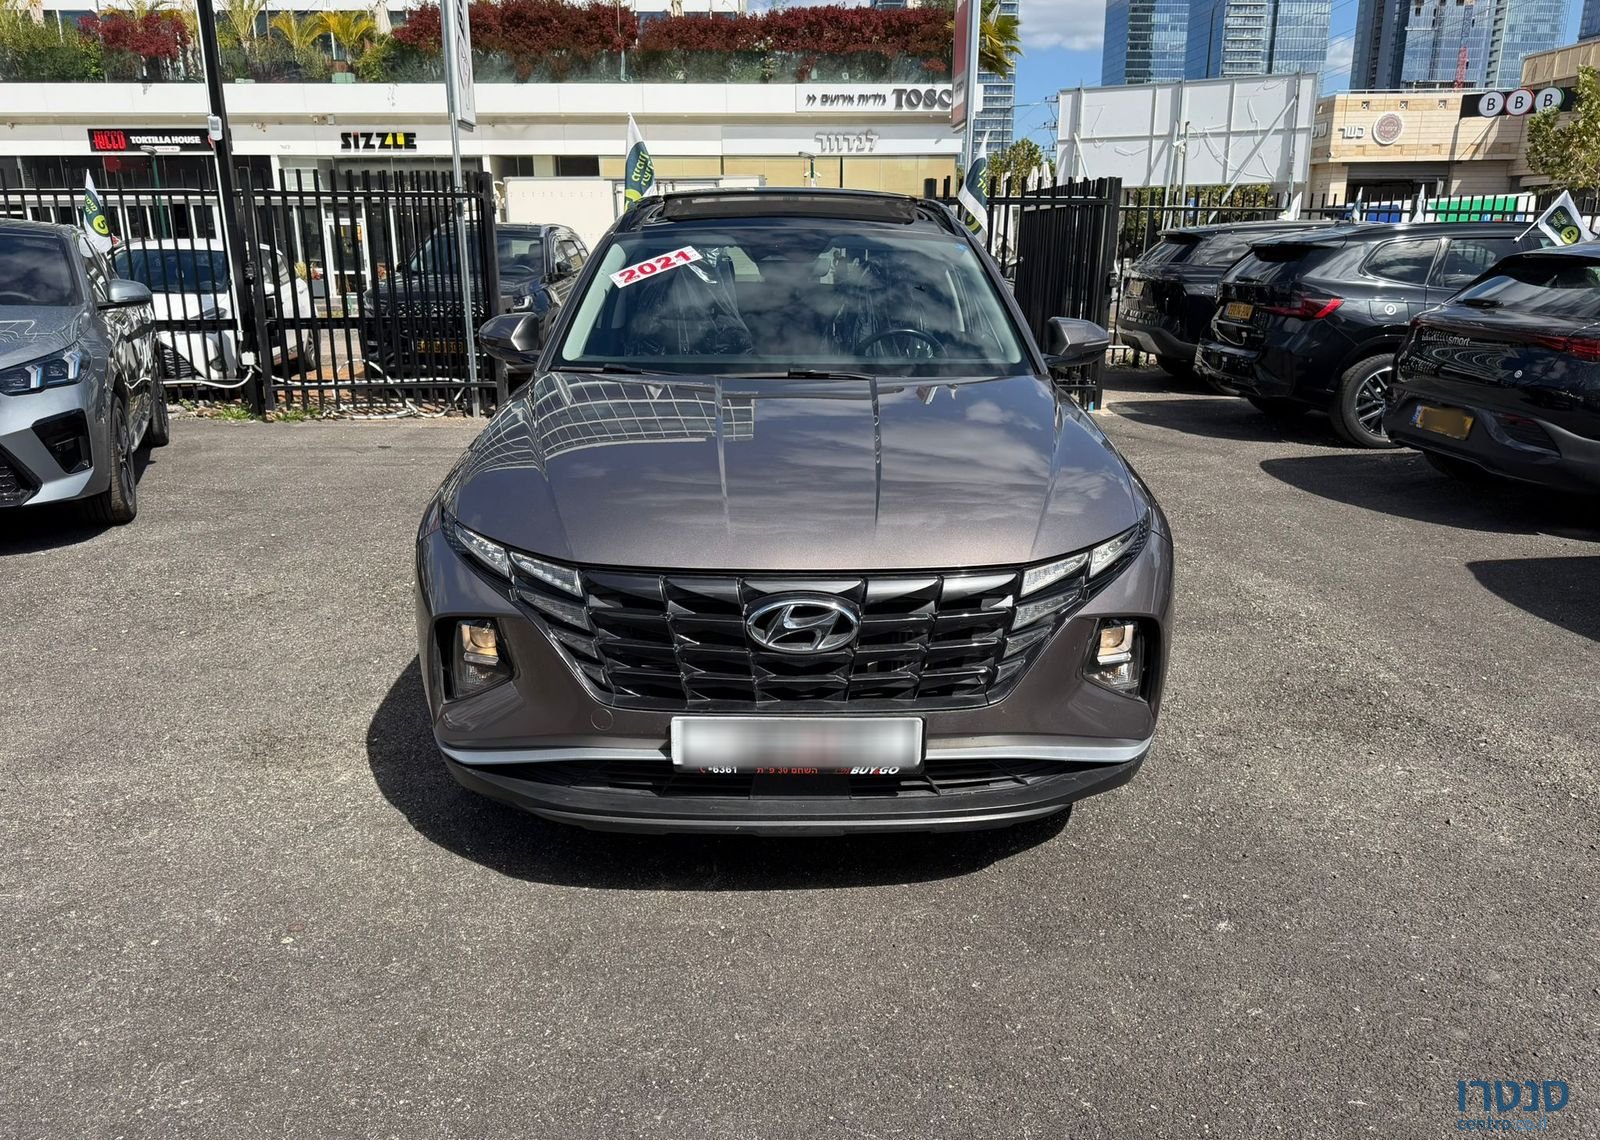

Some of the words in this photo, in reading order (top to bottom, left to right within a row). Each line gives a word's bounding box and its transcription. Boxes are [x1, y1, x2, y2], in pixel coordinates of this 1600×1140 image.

[1487, 97, 1496, 111] B
[1514, 96, 1524, 109] B
[1543, 94, 1553, 107] B
[130, 135, 172, 144] TORTILLA
[172, 135, 202, 144] HOUSE
[340, 131, 417, 149] SIZZLE
[815, 128, 880, 152] לנדוור
[1338, 126, 1365, 139] כשר
[1564, 229, 1575, 240] 5
[618, 250, 692, 283] 2021
[1448, 335, 1471, 346] smart
